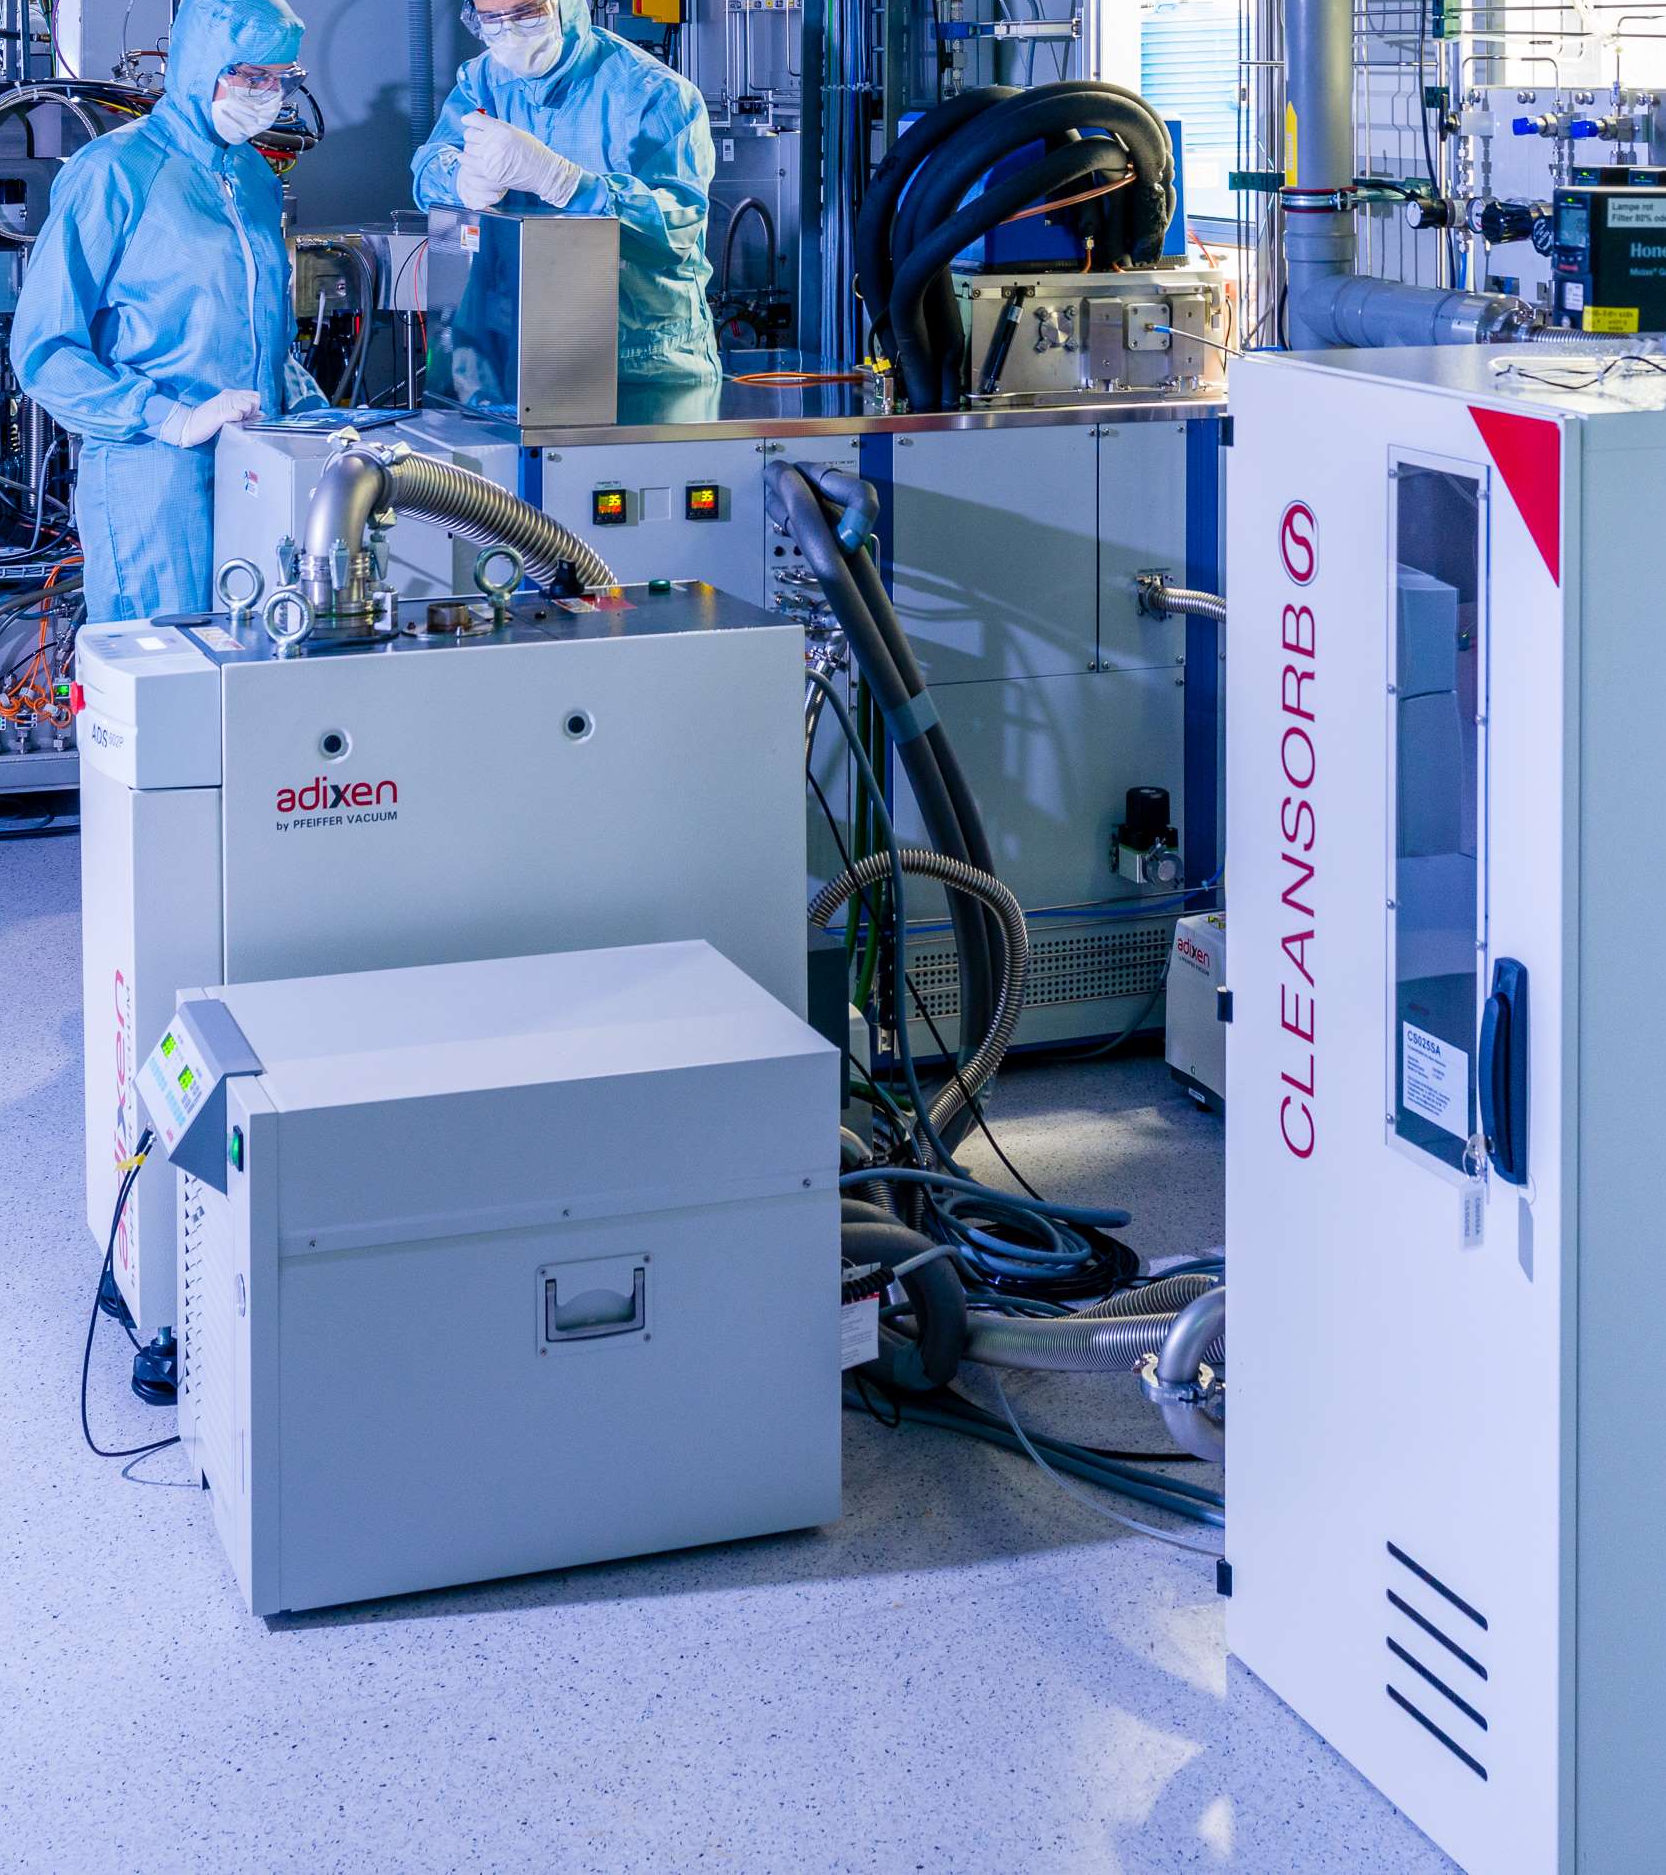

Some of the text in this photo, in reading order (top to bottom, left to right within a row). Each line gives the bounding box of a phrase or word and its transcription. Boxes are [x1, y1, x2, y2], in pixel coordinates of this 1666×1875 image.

[1612, 202, 1653, 212] Lampe rot
[1612, 214, 1633, 222] Filter
[1635, 214, 1652, 223] 80%
[92, 723, 108, 748] ADS
[276, 776, 398, 813] adixen
[276, 811, 398, 832] by PFEIFFER VACUUM
[1280, 603, 1316, 1159] CLEANSORB
[1177, 937, 1210, 967] adixen
[1407, 1030, 1441, 1056] CS025SA
